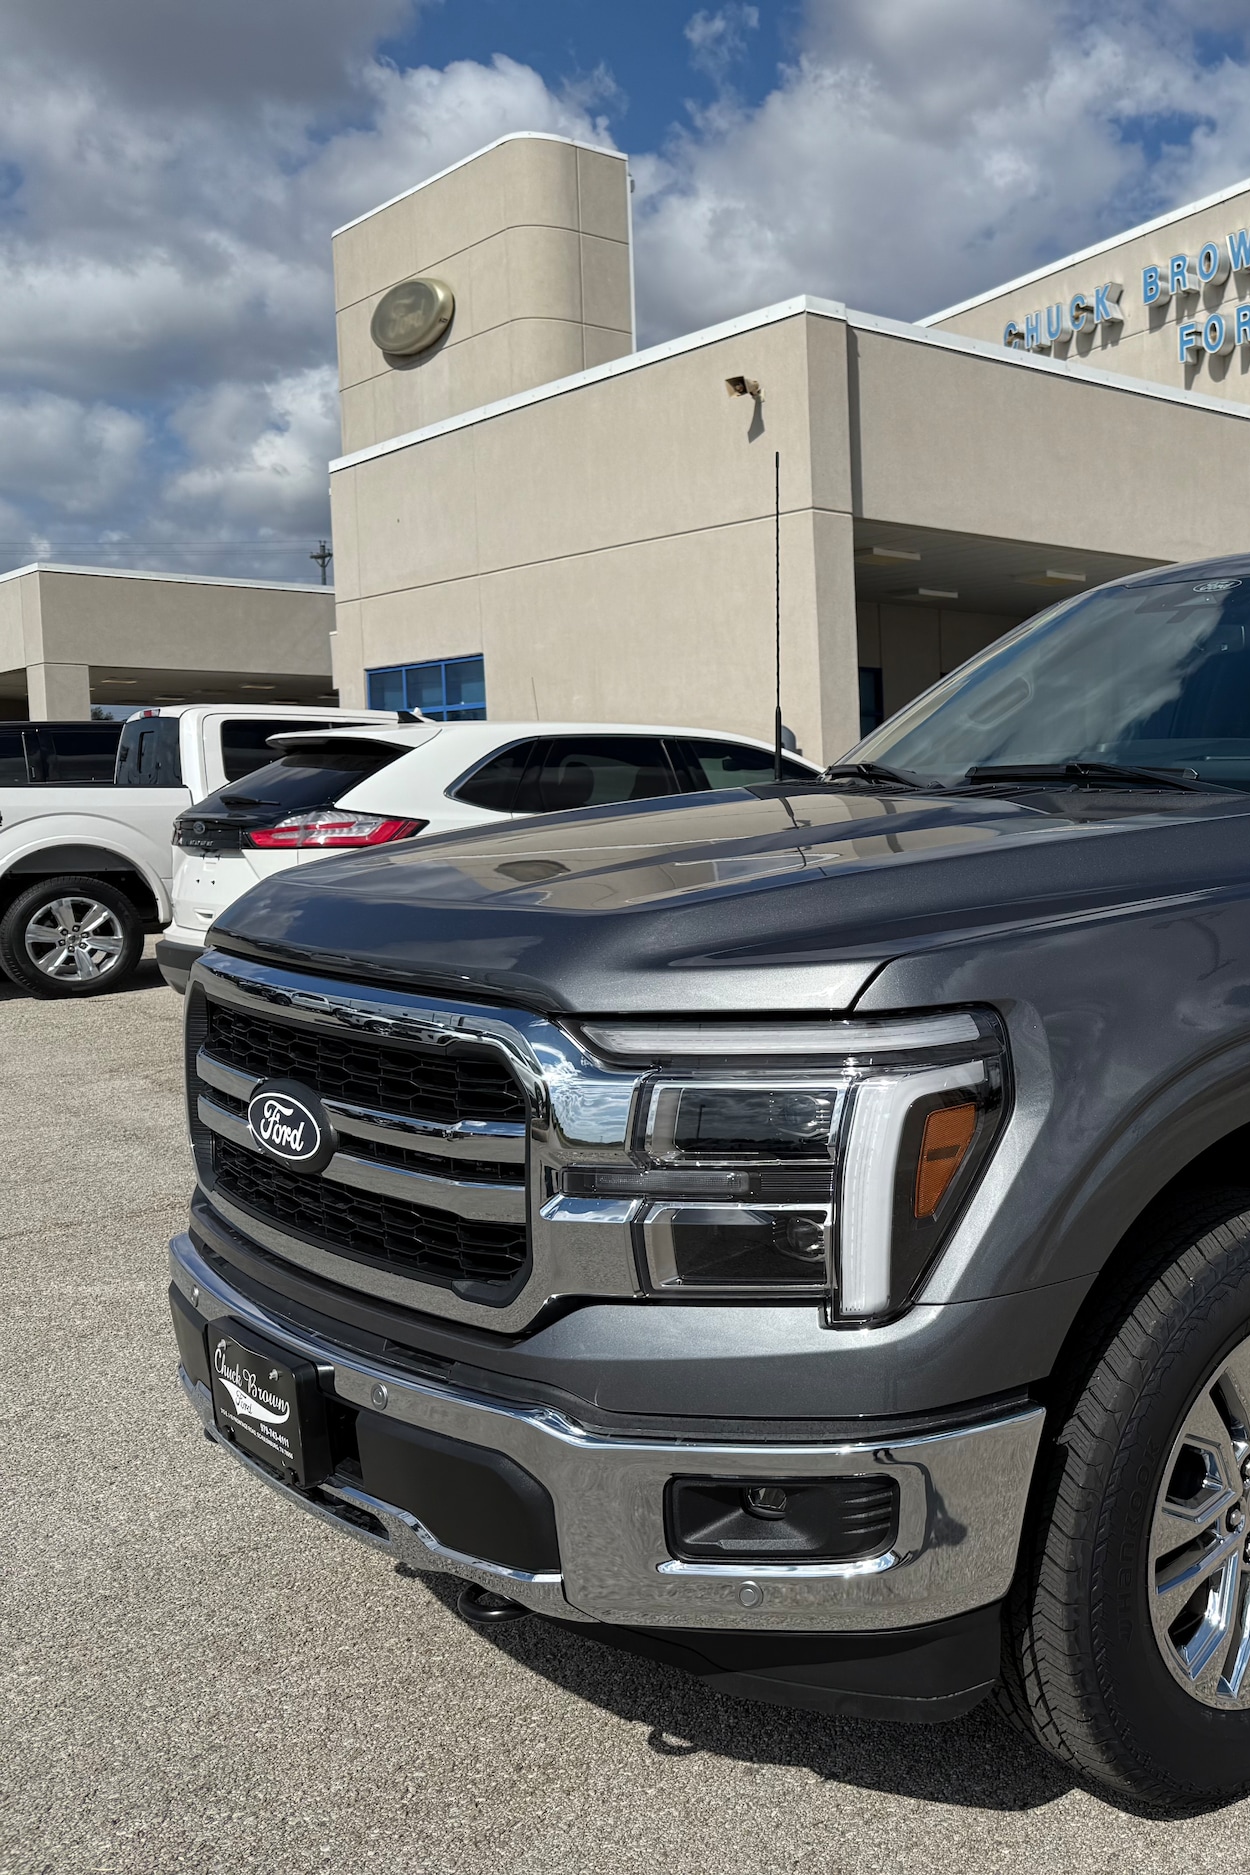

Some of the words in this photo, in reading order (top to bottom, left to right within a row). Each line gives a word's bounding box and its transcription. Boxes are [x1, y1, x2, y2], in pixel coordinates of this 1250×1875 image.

[1003, 281, 1123, 350] CHUCK
[1199, 581, 1235, 591] Ford
[260, 1100, 304, 1151] Ford
[214, 1348, 242, 1388] Chuck
[242, 1368, 289, 1414] Brown
[236, 1390, 253, 1414] Ford
